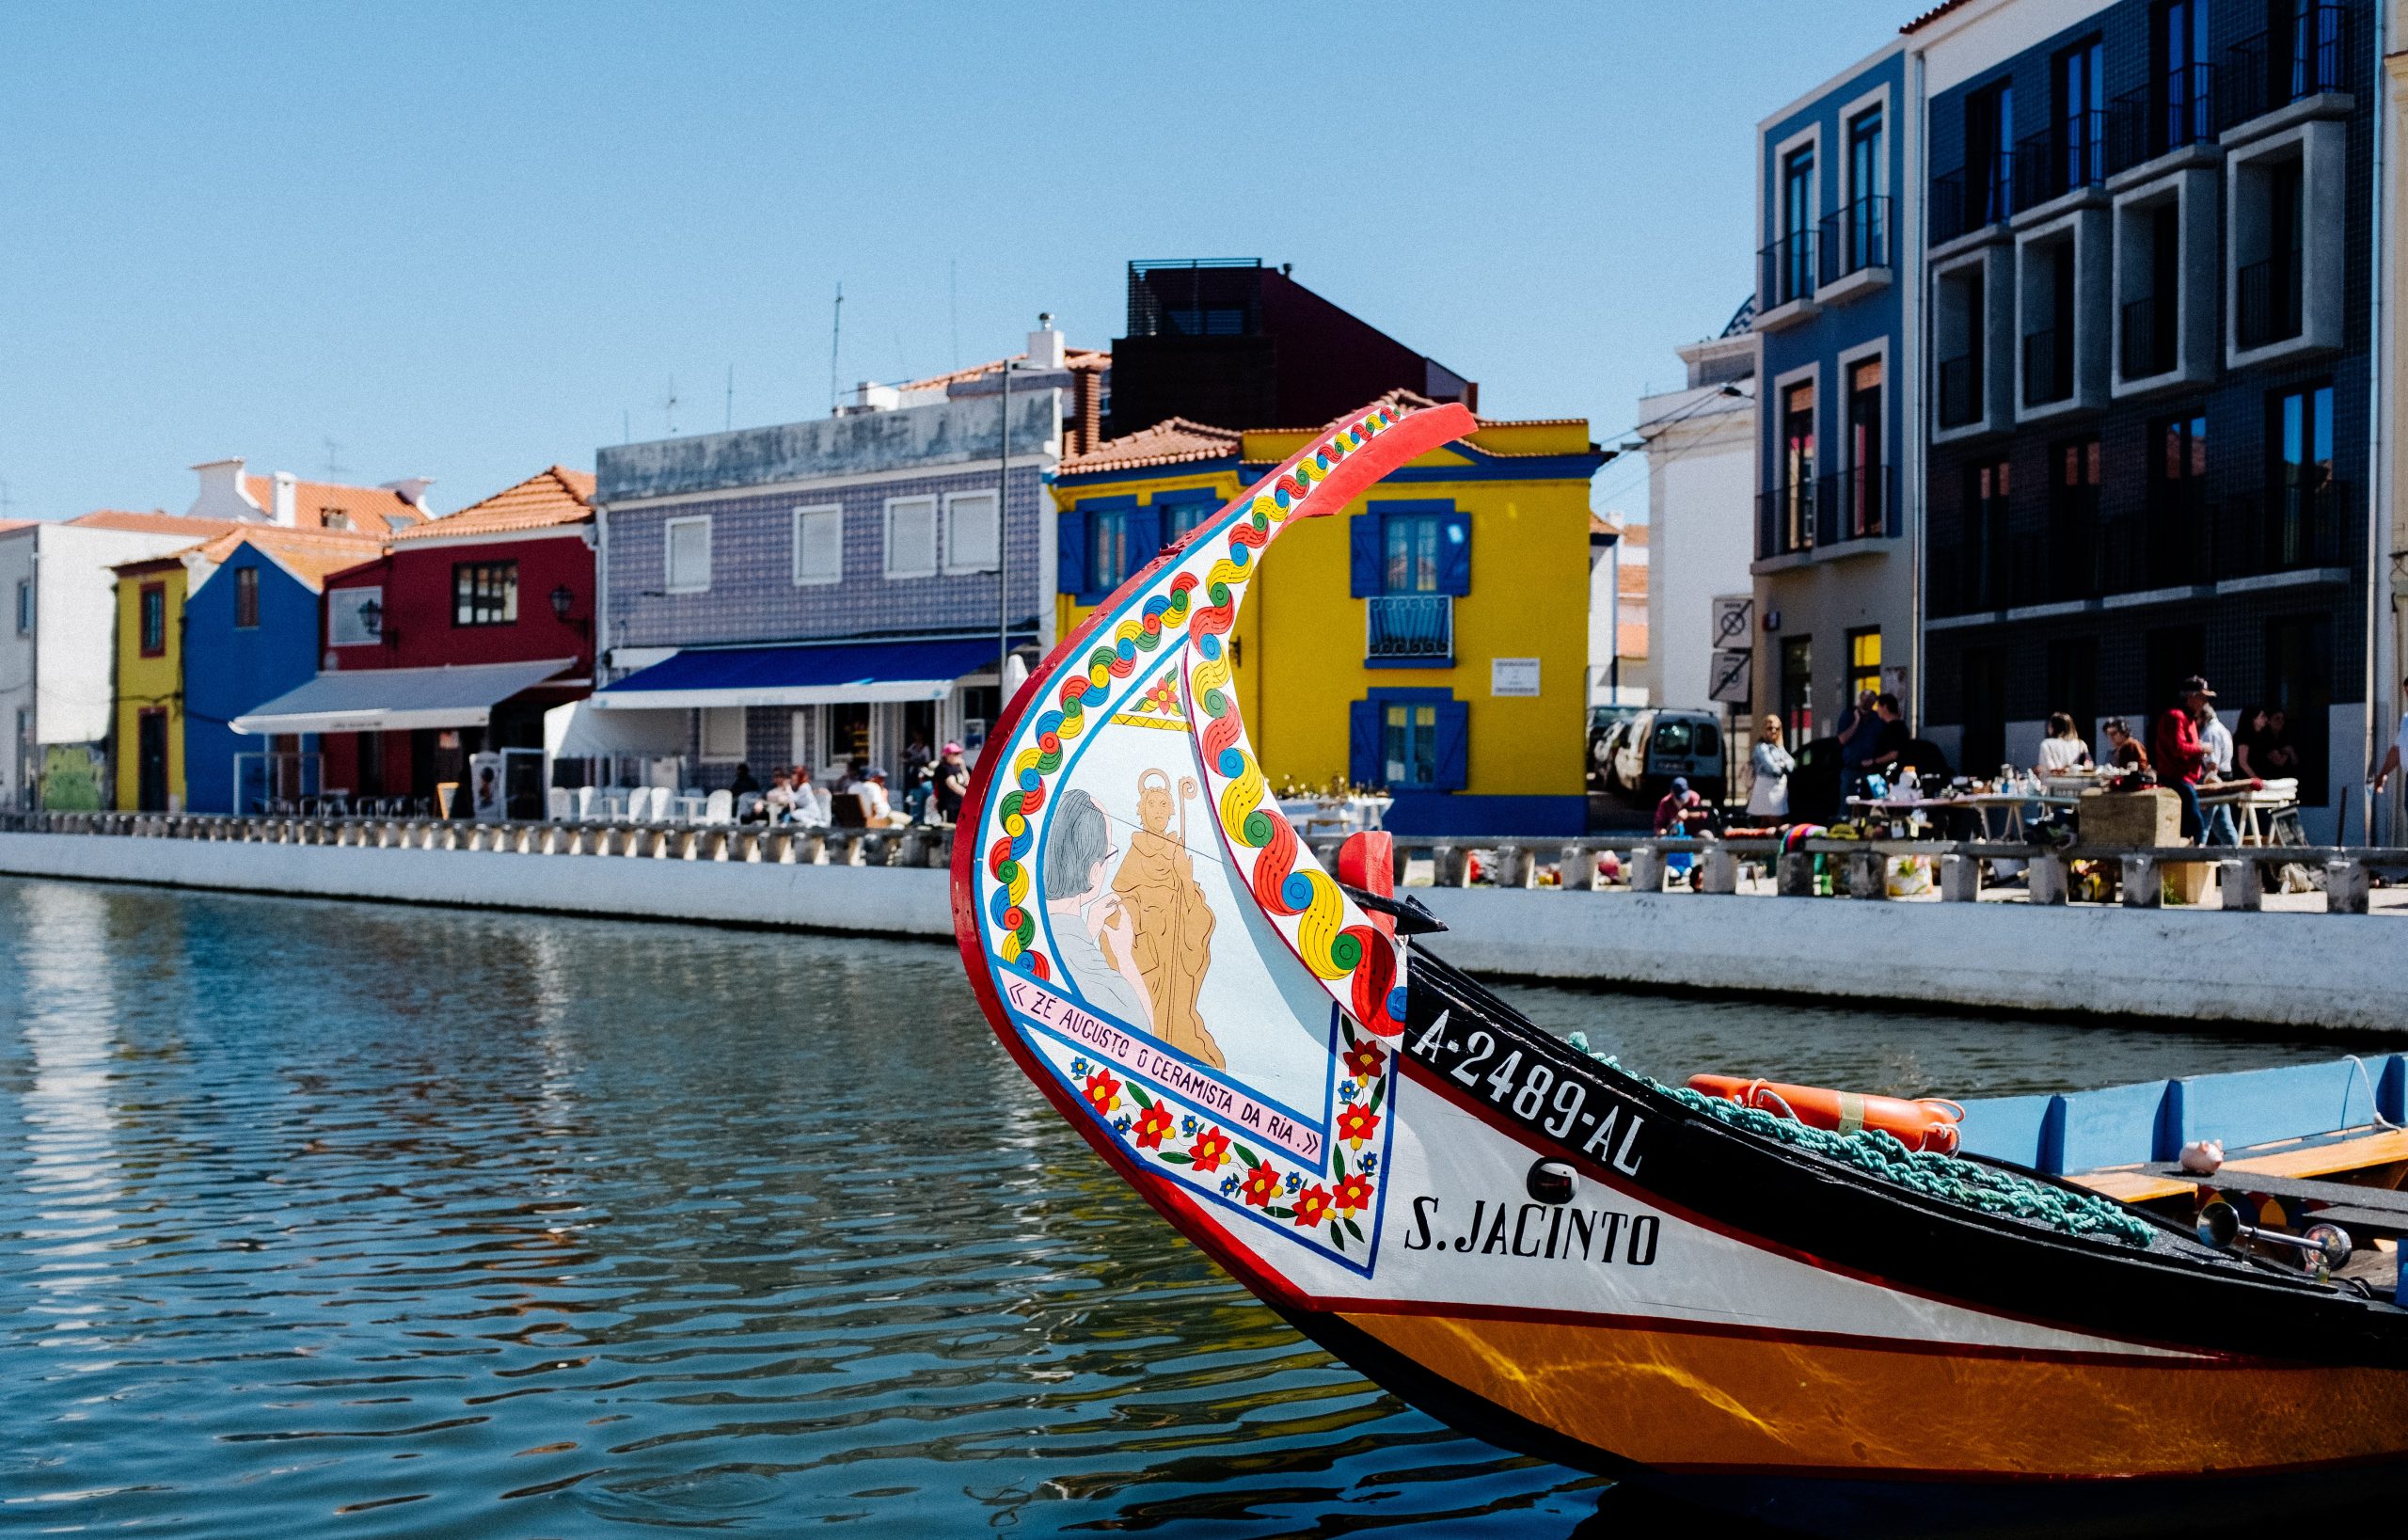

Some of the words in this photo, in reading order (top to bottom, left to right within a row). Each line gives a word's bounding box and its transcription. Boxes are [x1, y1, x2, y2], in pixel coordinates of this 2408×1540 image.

[1059, 1008, 1130, 1058] AUGUSTO
[1136, 1048, 1149, 1068] O
[1151, 1056, 1233, 1113] CERAMISTA
[1241, 1103, 1260, 1128] DA
[1411, 1008, 1645, 1176] A-2489-AL
